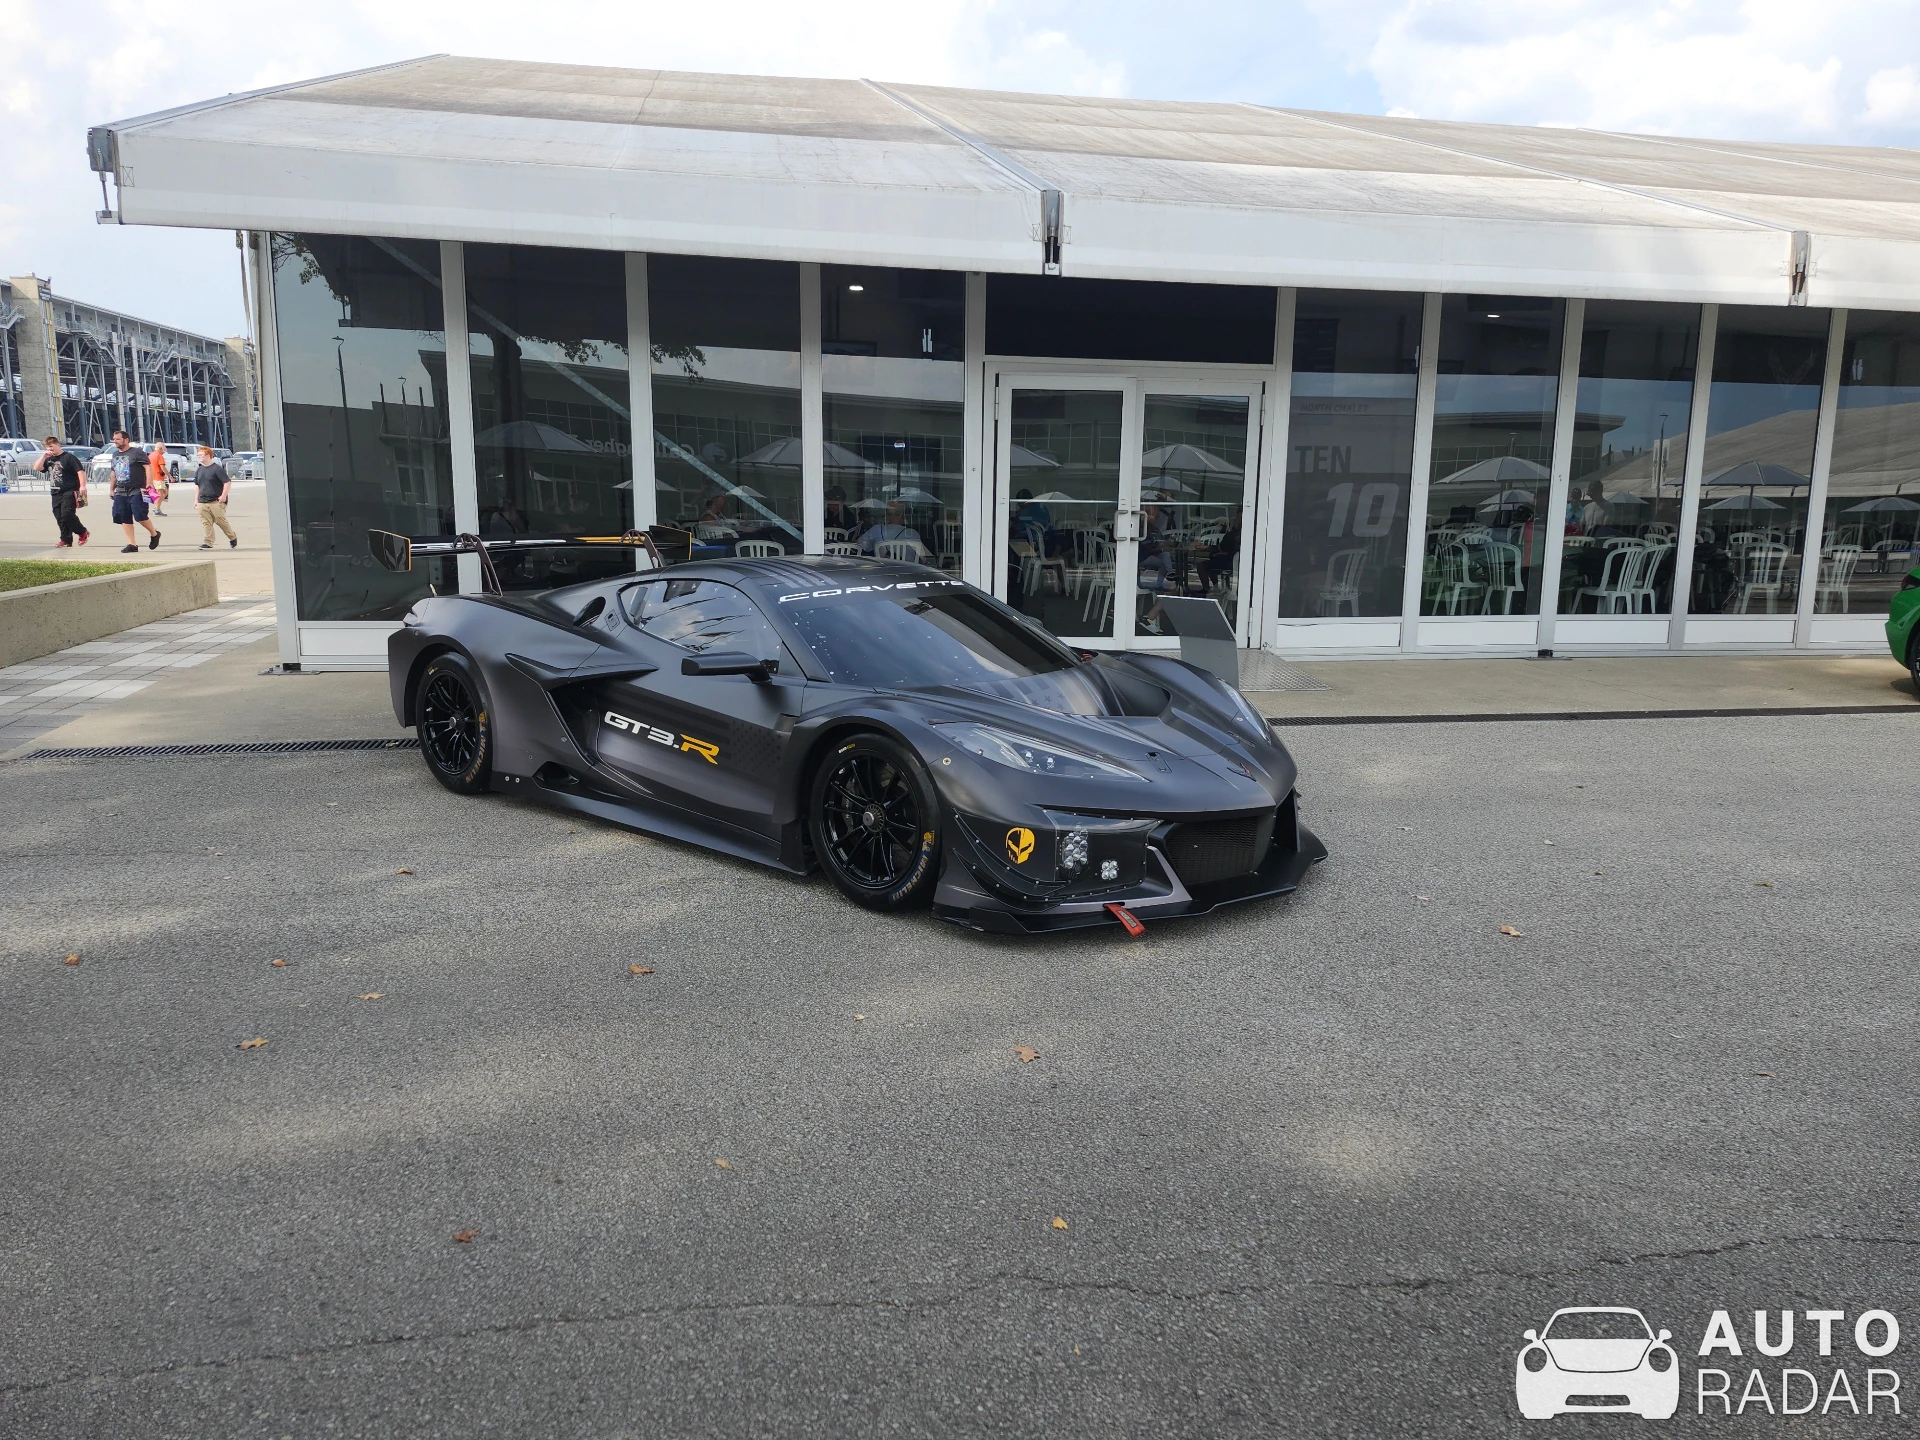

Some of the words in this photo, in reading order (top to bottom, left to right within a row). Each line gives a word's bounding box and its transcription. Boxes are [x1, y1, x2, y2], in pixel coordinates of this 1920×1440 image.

[1295, 446, 1351, 473] TEN
[1327, 483, 1399, 537] 10
[779, 580, 964, 602] CORVETTE
[893, 856, 929, 900] MICHELIN
